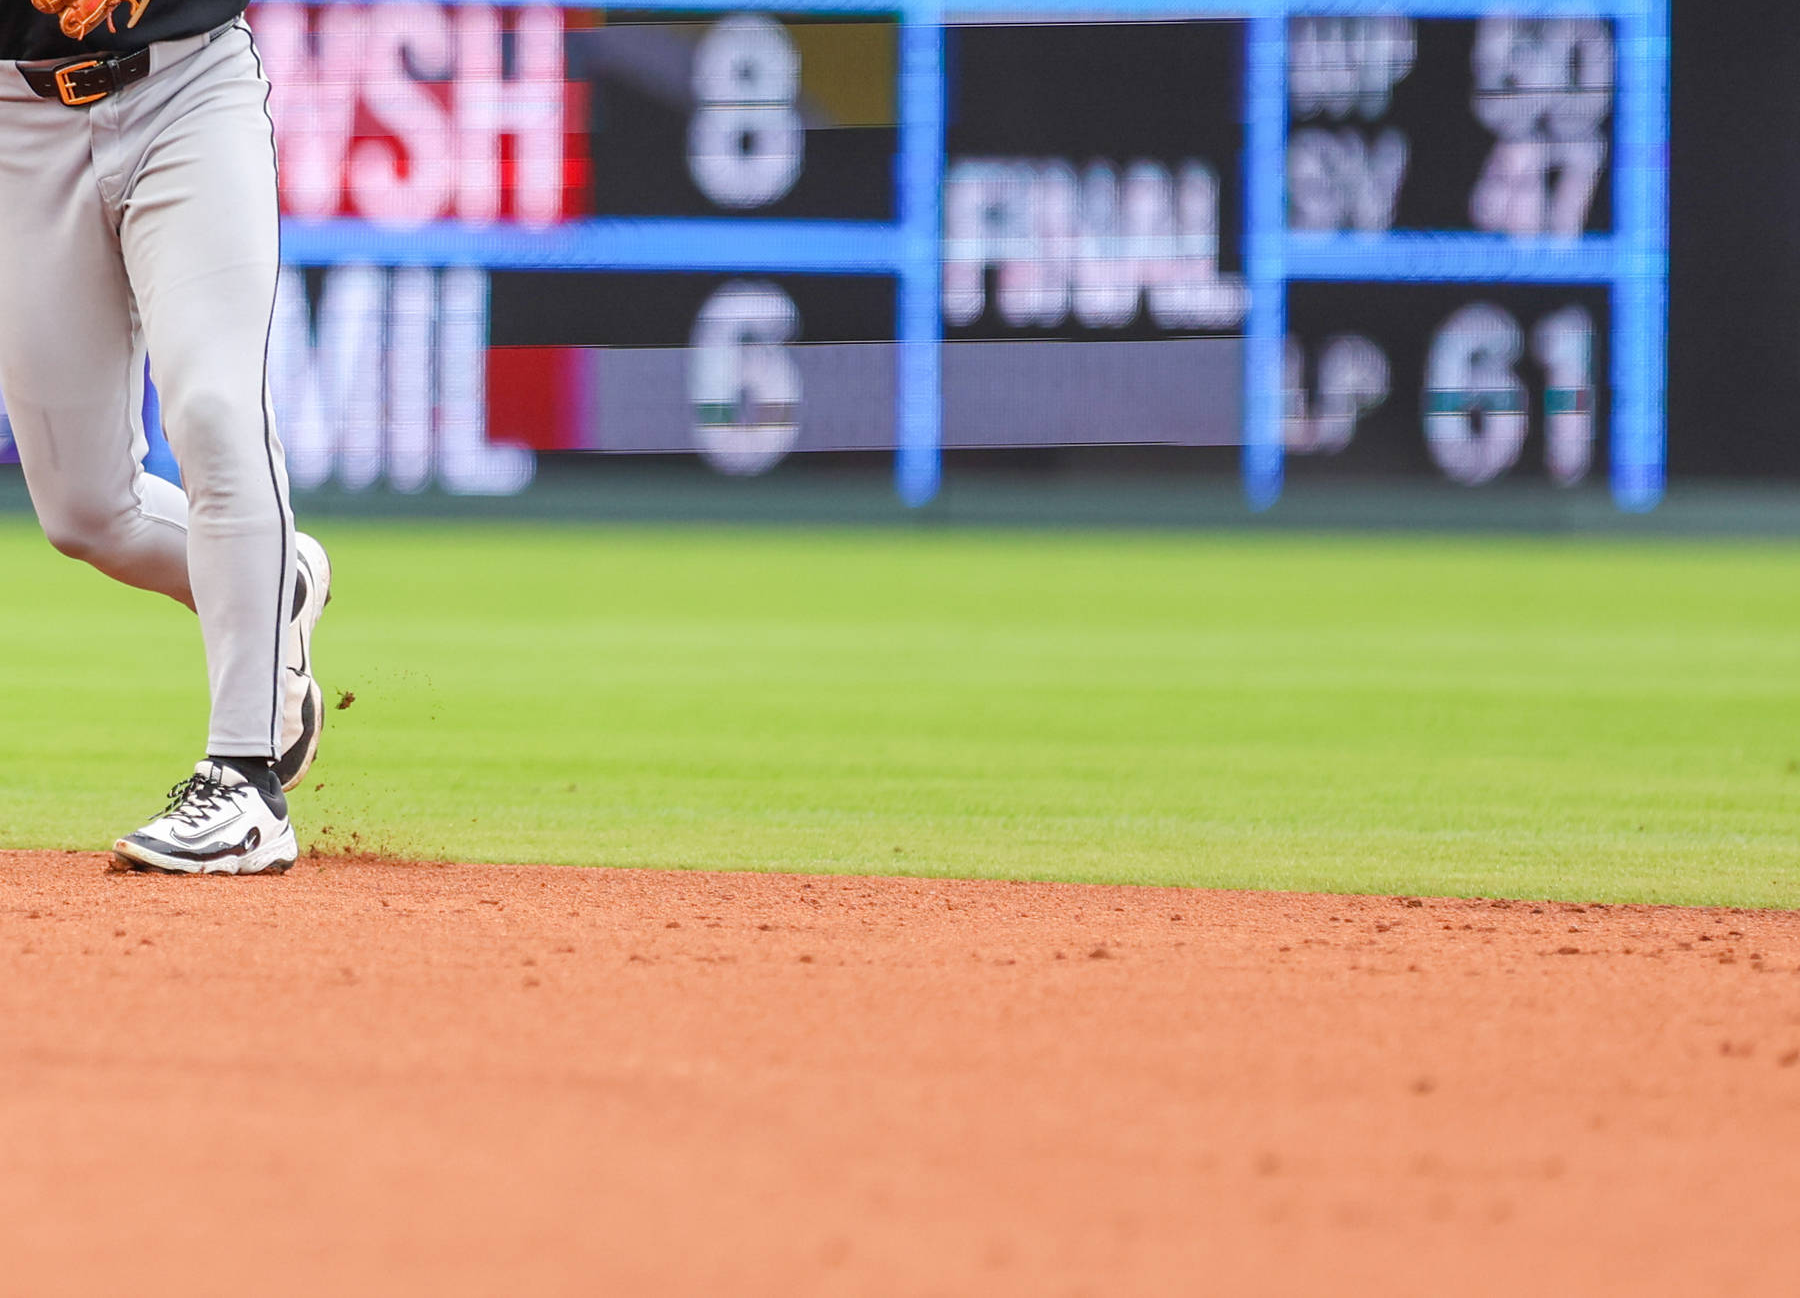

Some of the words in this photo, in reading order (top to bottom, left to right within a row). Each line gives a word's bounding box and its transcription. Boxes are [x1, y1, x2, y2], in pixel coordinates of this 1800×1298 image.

[686, 12, 803, 210] 8
[942, 154, 1252, 330] FINAL
[688, 280, 802, 478] 6
[1422, 304, 1598, 486] 61
